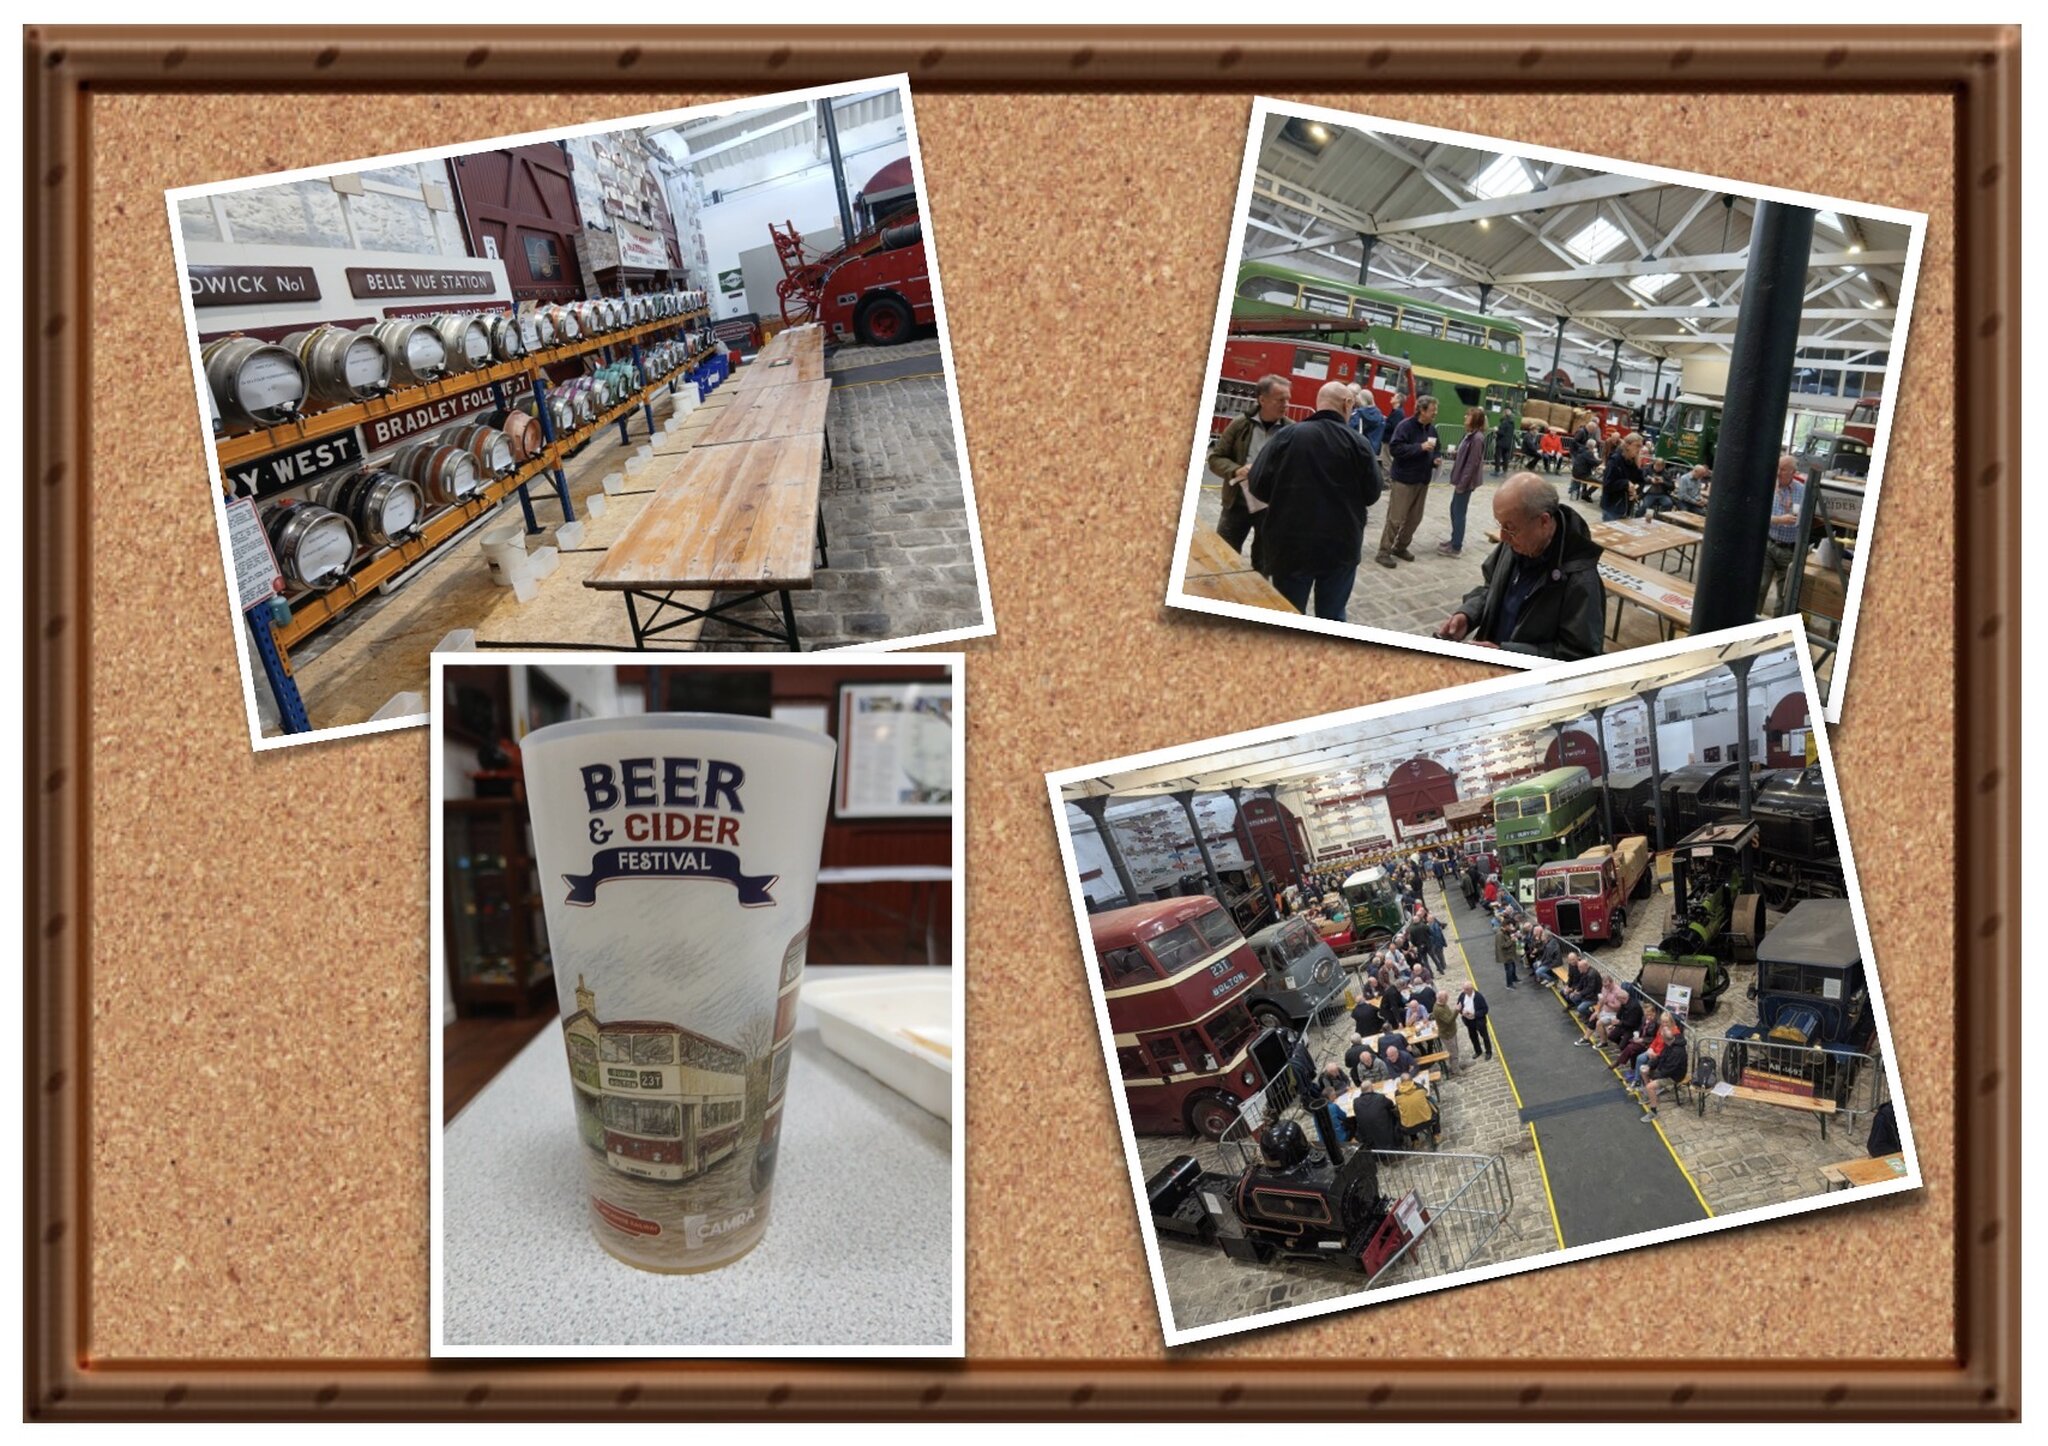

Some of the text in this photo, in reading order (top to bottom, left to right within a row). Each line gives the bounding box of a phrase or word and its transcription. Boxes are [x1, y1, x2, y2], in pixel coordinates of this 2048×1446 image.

[366, 274, 488, 290] BELLE VUE STATION
[375, 398, 458, 443] BRADLEY
[461, 386, 496, 412] FOLD
[272, 437, 349, 484] WEST
[579, 757, 746, 814] BEER
[588, 812, 740, 847] & CIDER
[618, 852, 712, 871] FESTIVAL
[1212, 971, 1245, 996] BOLTON
[641, 1074, 662, 1087] 23T
[696, 1208, 756, 1239] CAMRA
